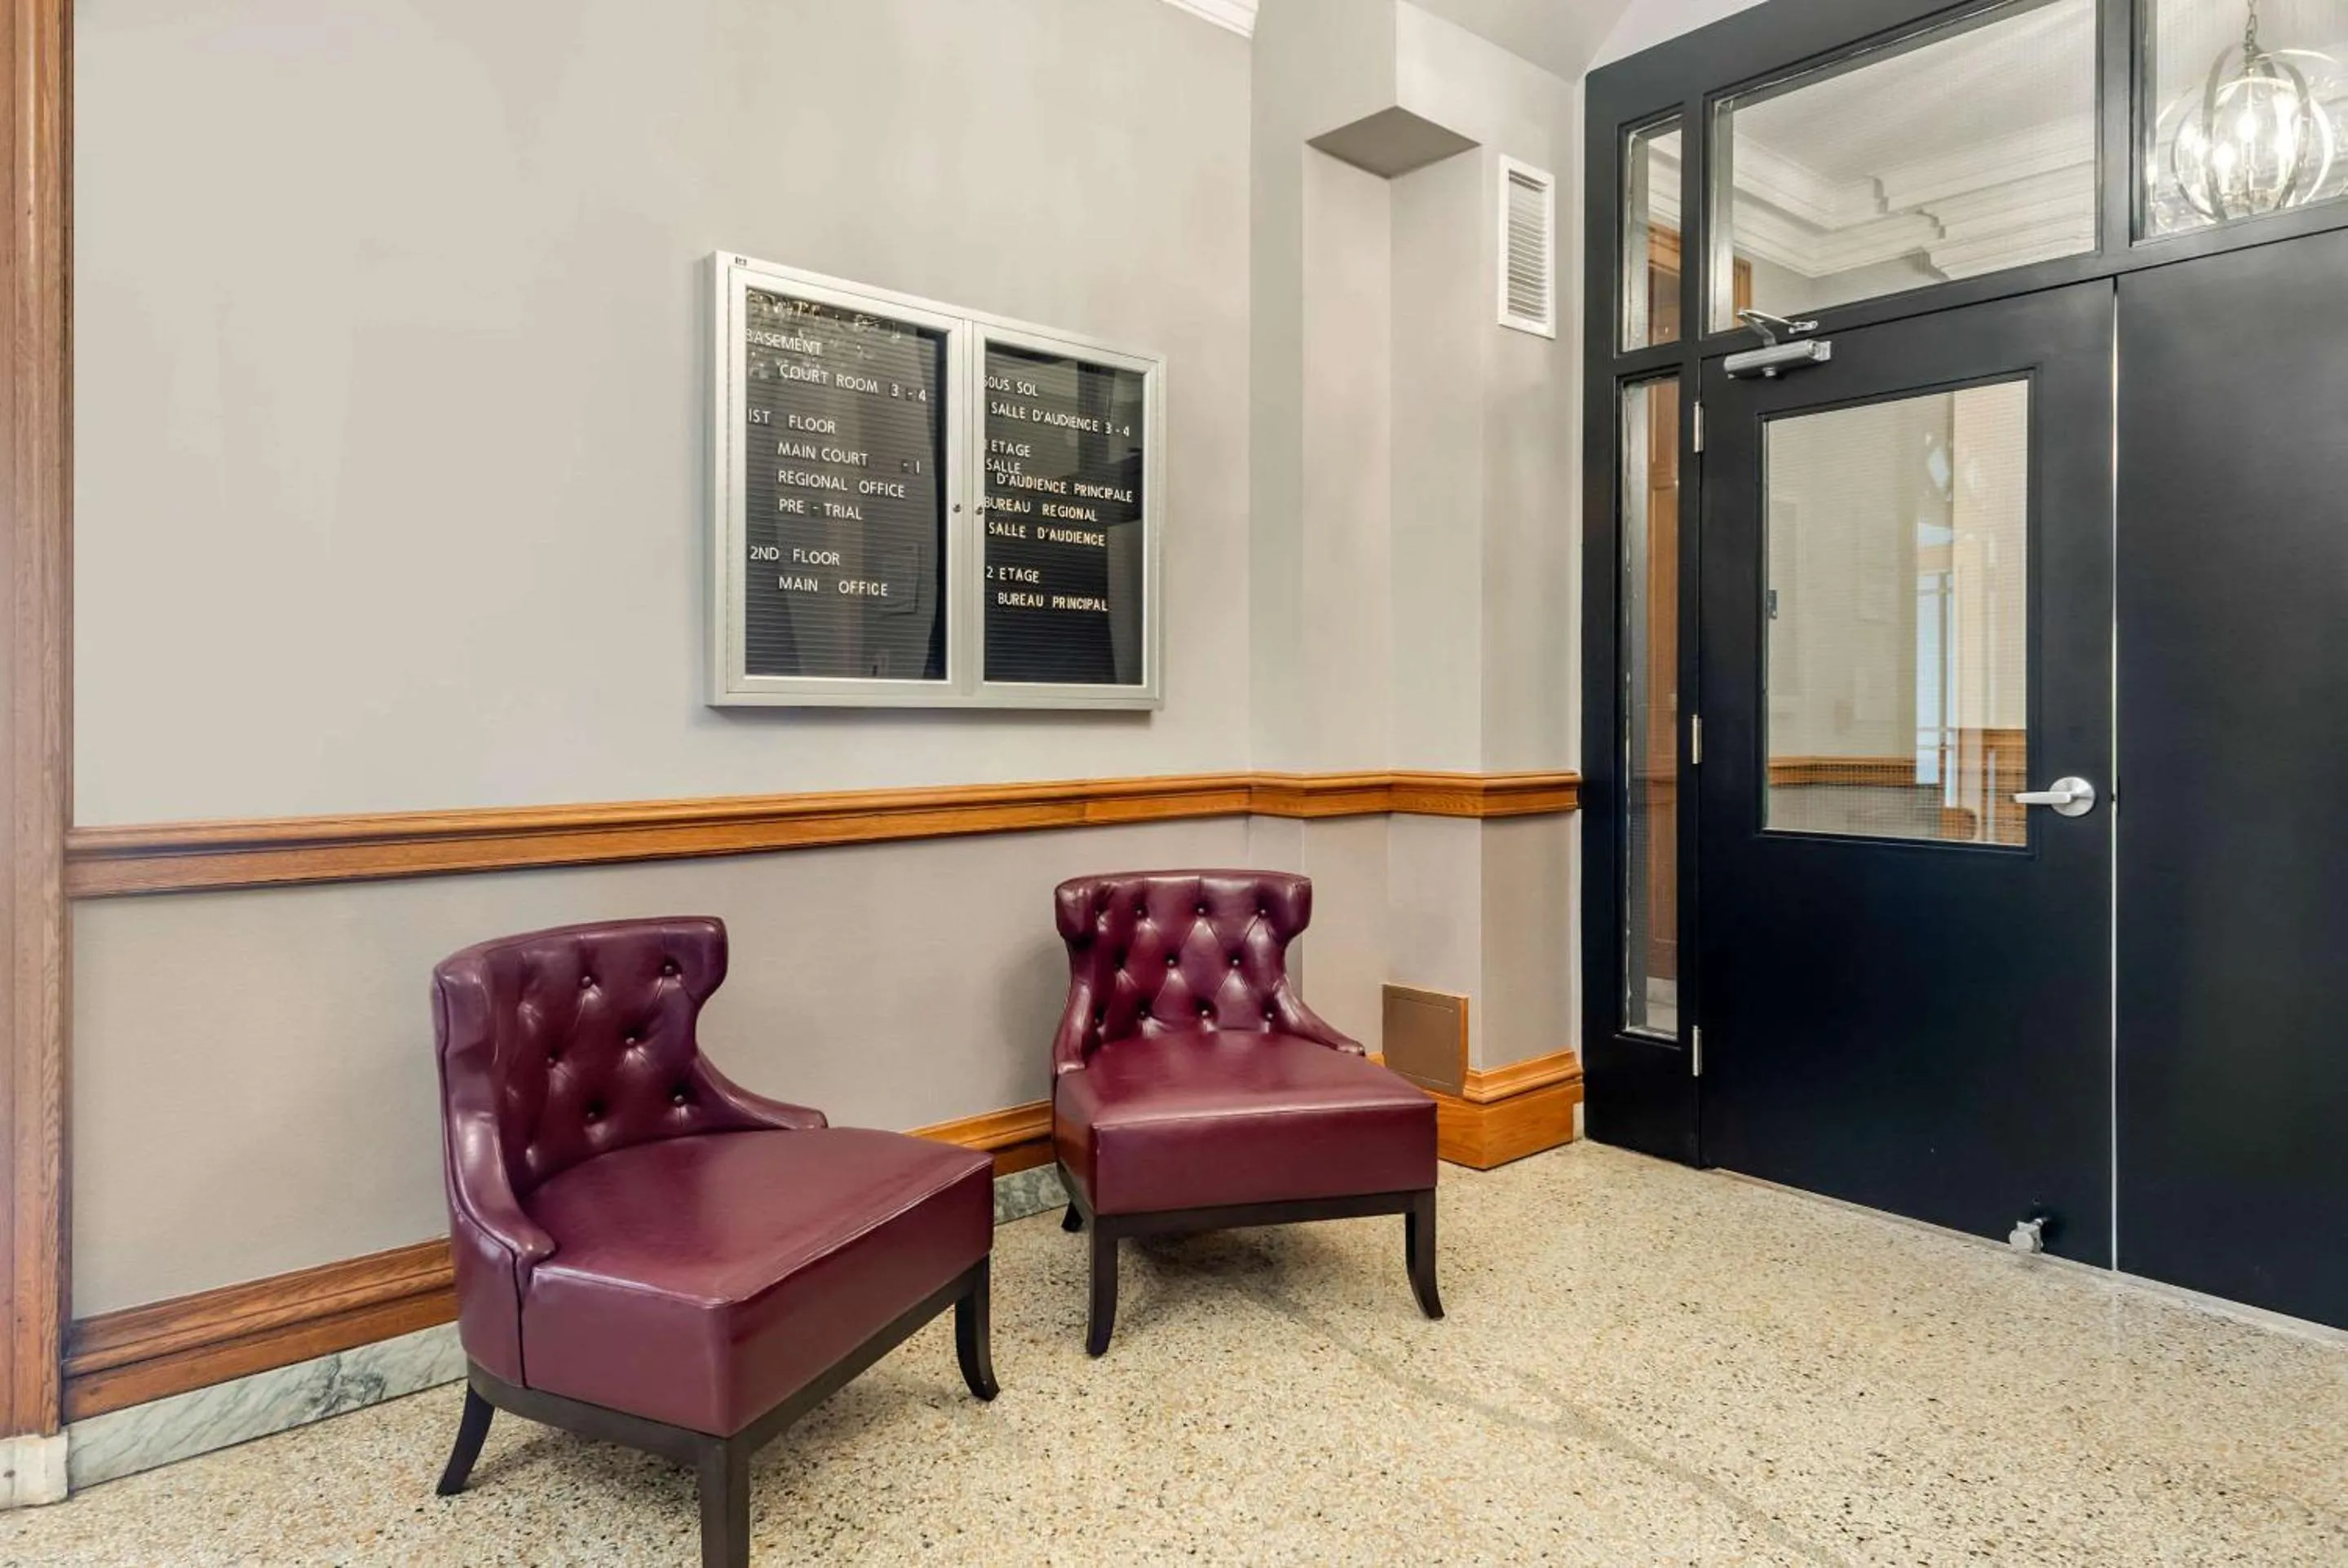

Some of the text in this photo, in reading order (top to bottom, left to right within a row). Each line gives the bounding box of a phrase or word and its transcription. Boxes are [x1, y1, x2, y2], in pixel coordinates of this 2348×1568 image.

[780, 364, 829, 383] COURT
[836, 373, 878, 393] ROOM
[891, 383, 898, 396] 3
[918, 389, 926, 402] 4
[1016, 382, 1039, 397] SOL
[789, 414, 836, 434] FLOOR
[991, 401, 1026, 419] SALLE
[1033, 409, 1099, 432] D'AUDIENCE
[1104, 422, 1112, 435] 3
[1123, 426, 1130, 437] 4
[777, 442, 816, 460] MAIN
[821, 448, 868, 466] COURT
[991, 439, 1031, 457] ETAGE
[985, 457, 1021, 474] SALLE
[778, 470, 905, 498] REGIONAL OFFICE
[997, 473, 1133, 503] D'AUDIENCE PRINCIPALE
[779, 498, 805, 514] PRE
[824, 503, 863, 520] TRIAL
[984, 496, 1099, 522] BUREAU REGIONAL
[988, 522, 1106, 547] SALLE D'AUDIENCE
[750, 545, 840, 566] 2ND FLOOR
[986, 566, 1040, 584] 2 ETAGE
[779, 576, 888, 597] MAIN OFFICE
[997, 592, 1108, 612] BUREAU PRINCIPAL
